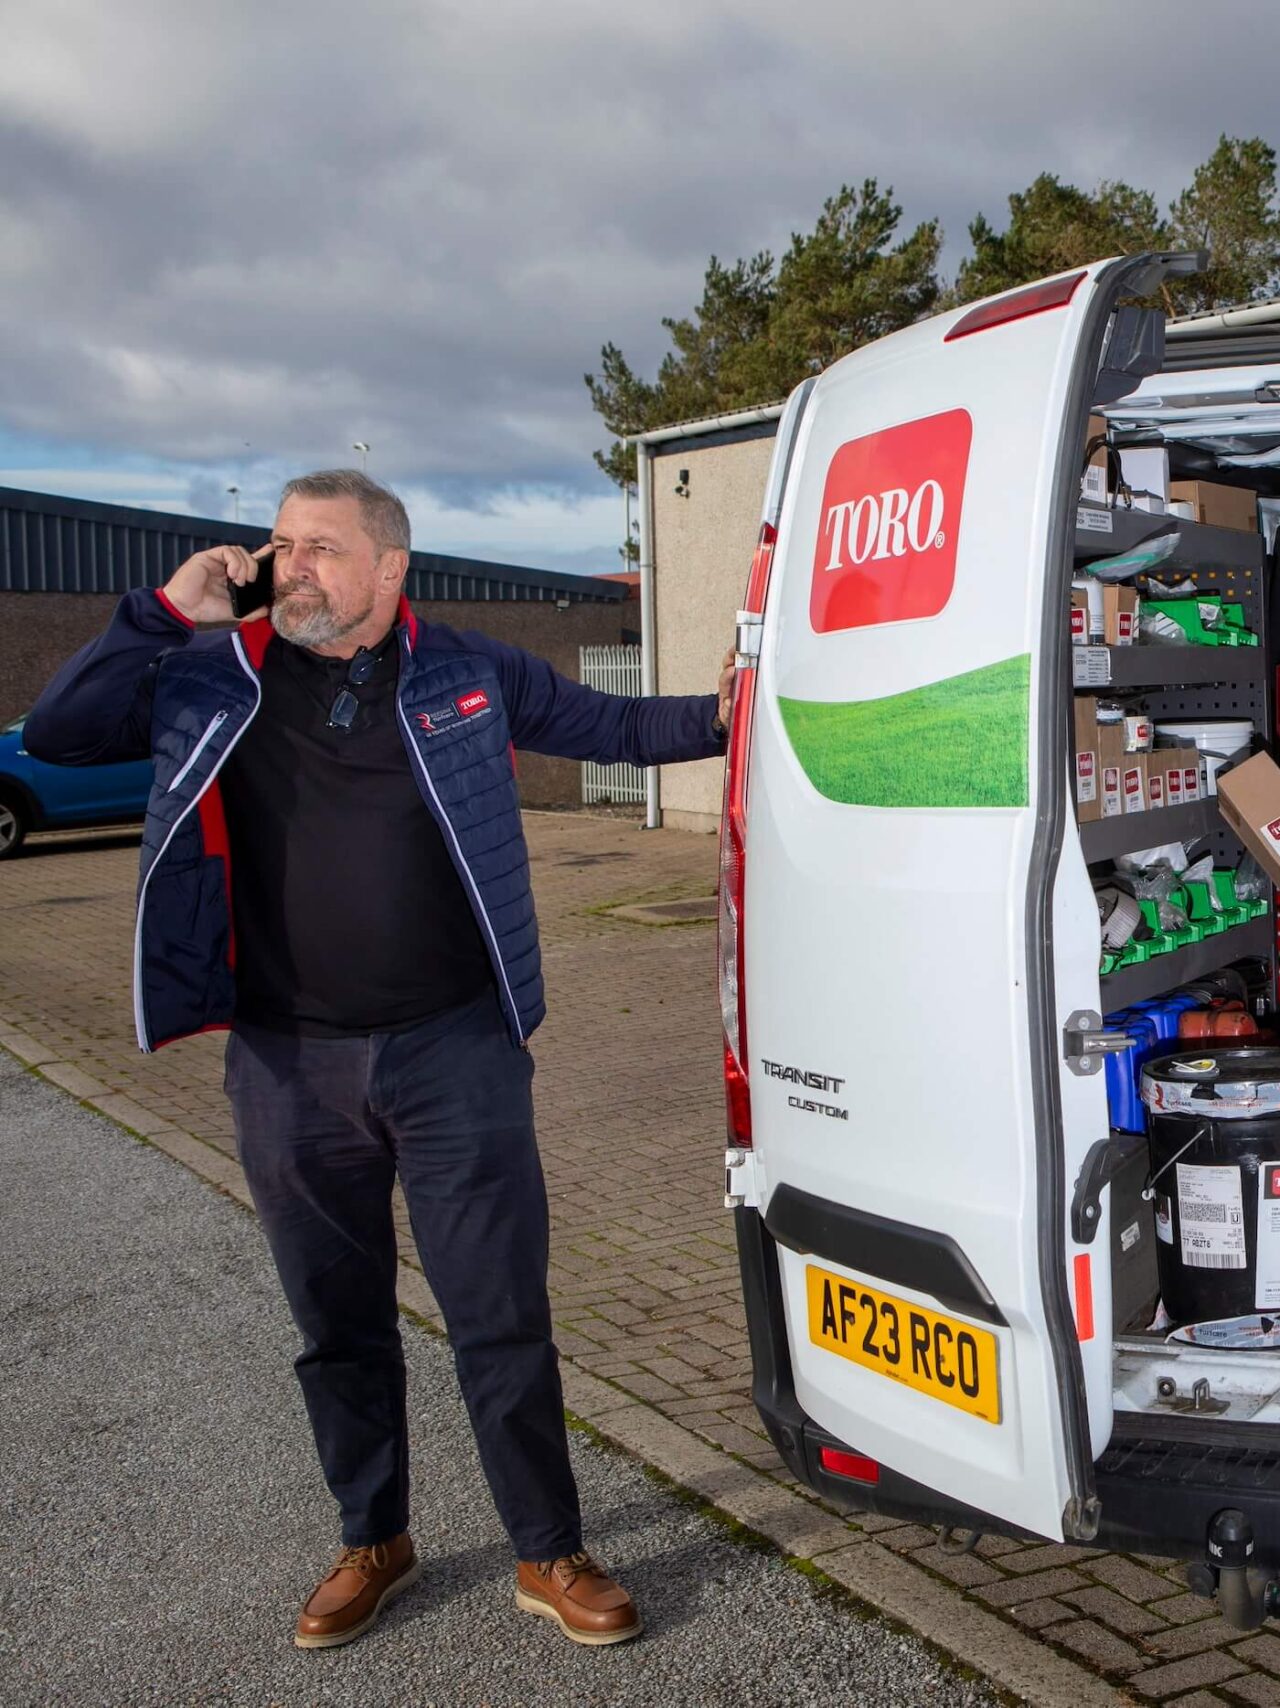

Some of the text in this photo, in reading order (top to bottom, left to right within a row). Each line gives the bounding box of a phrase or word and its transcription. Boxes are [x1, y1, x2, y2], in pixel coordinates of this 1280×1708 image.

[460, 694, 484, 710] TORO
[761, 1058, 845, 1094] TRANSIT
[788, 1095, 849, 1120] CUSTOM
[821, 1278, 981, 1398] AF23 RCO
